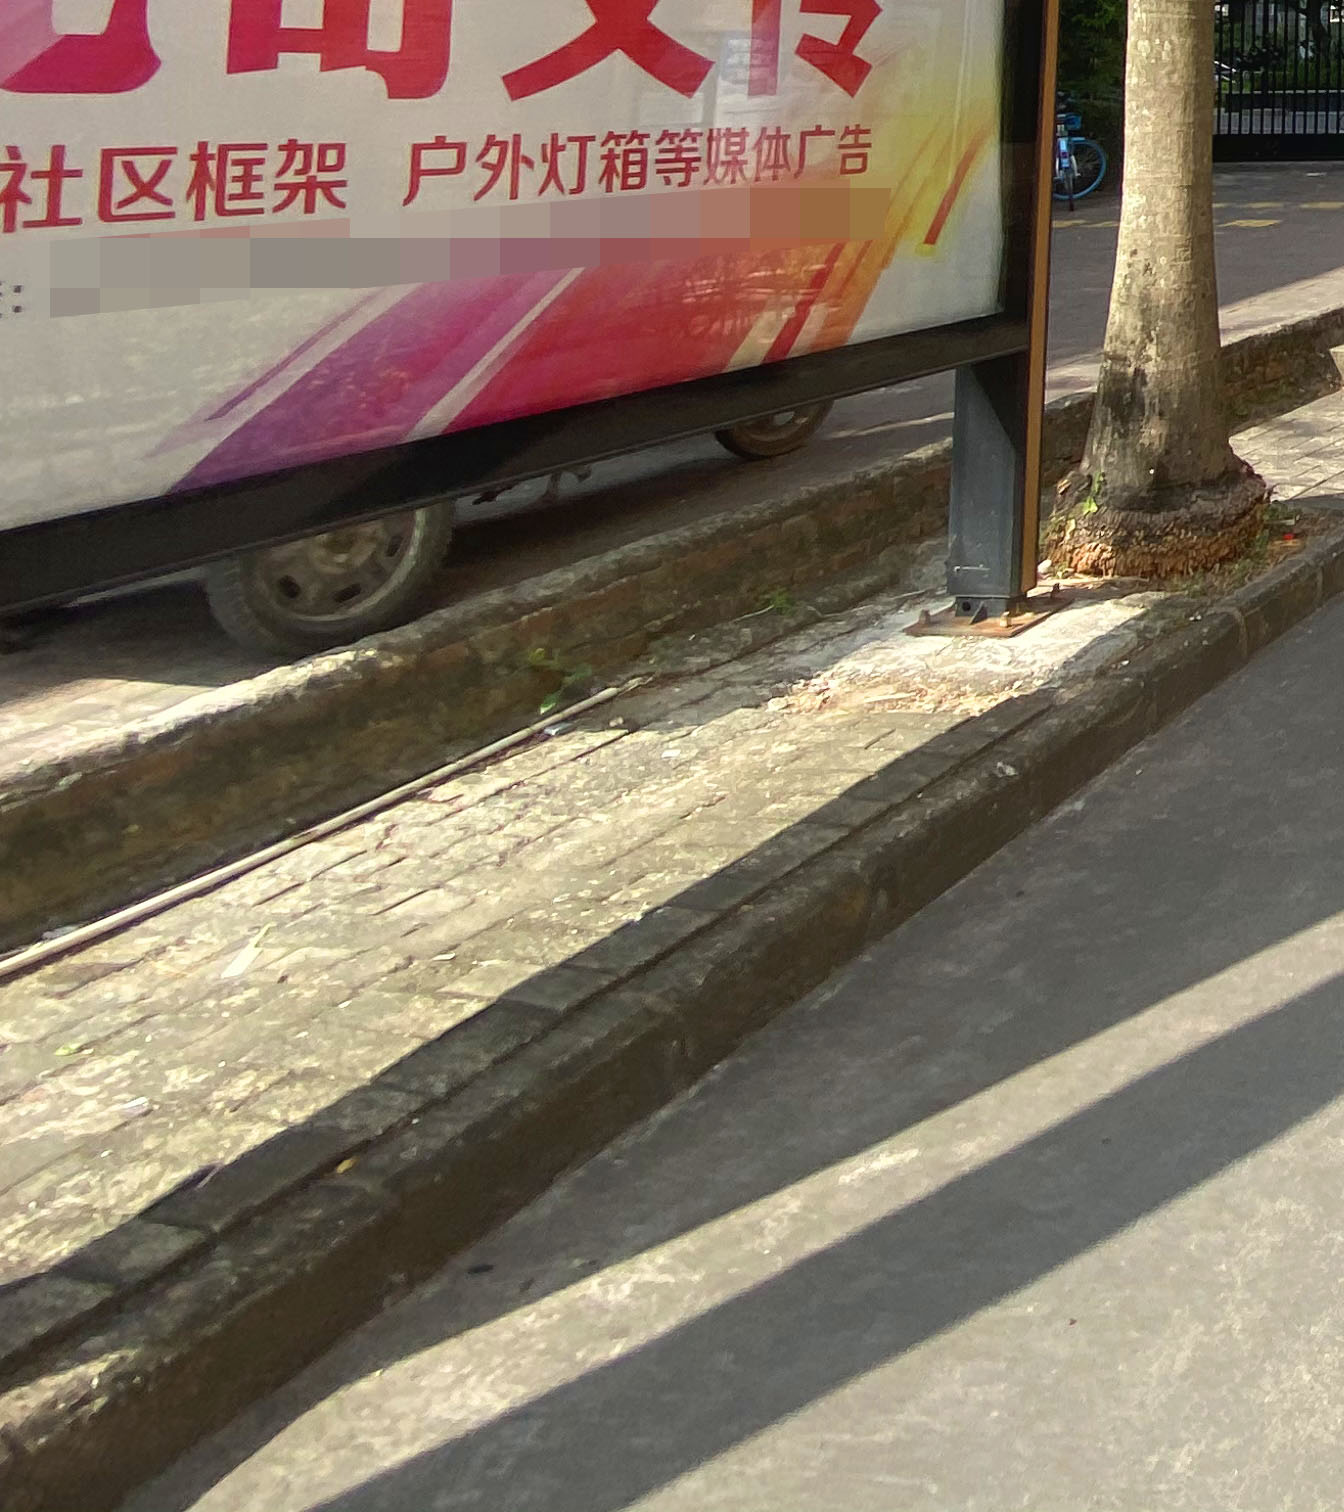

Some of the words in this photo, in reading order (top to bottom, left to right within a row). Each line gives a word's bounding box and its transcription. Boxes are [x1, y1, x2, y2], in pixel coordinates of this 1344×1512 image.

[0, 138, 348, 233] 社区框架
[401, 123, 872, 207] 户外灯箱等媒体广告
